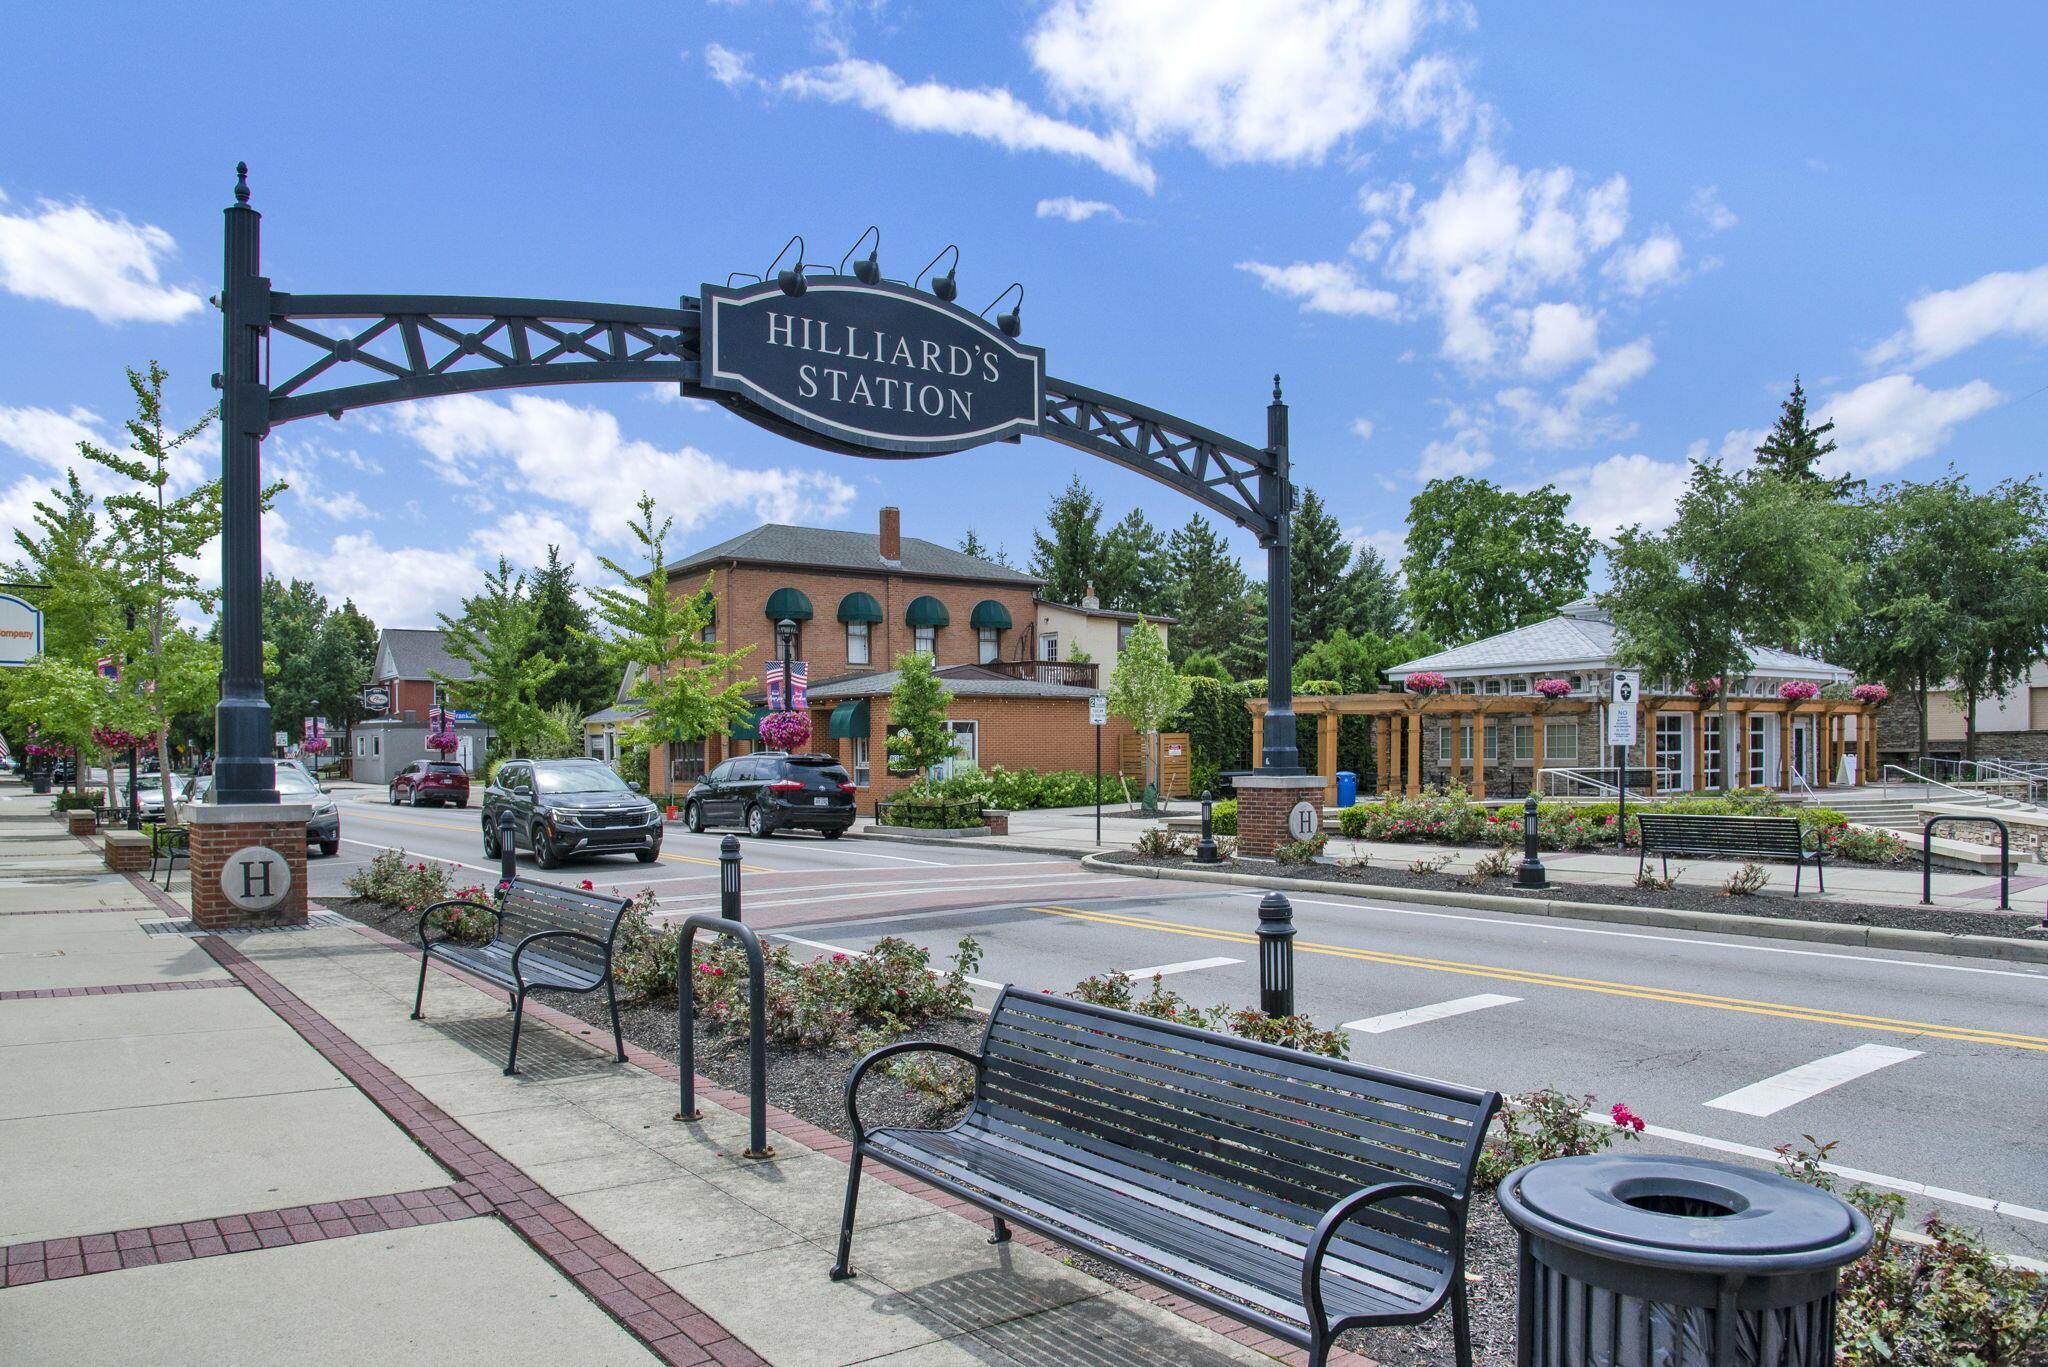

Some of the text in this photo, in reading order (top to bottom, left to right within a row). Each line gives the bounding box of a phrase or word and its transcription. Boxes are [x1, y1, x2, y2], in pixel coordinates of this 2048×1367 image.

[766, 311, 1000, 383] HILLIARD'S
[798, 364, 973, 422] STATION
[0, 630, 33, 639] ompany
[1298, 810, 1313, 834] H
[238, 860, 275, 898] H
